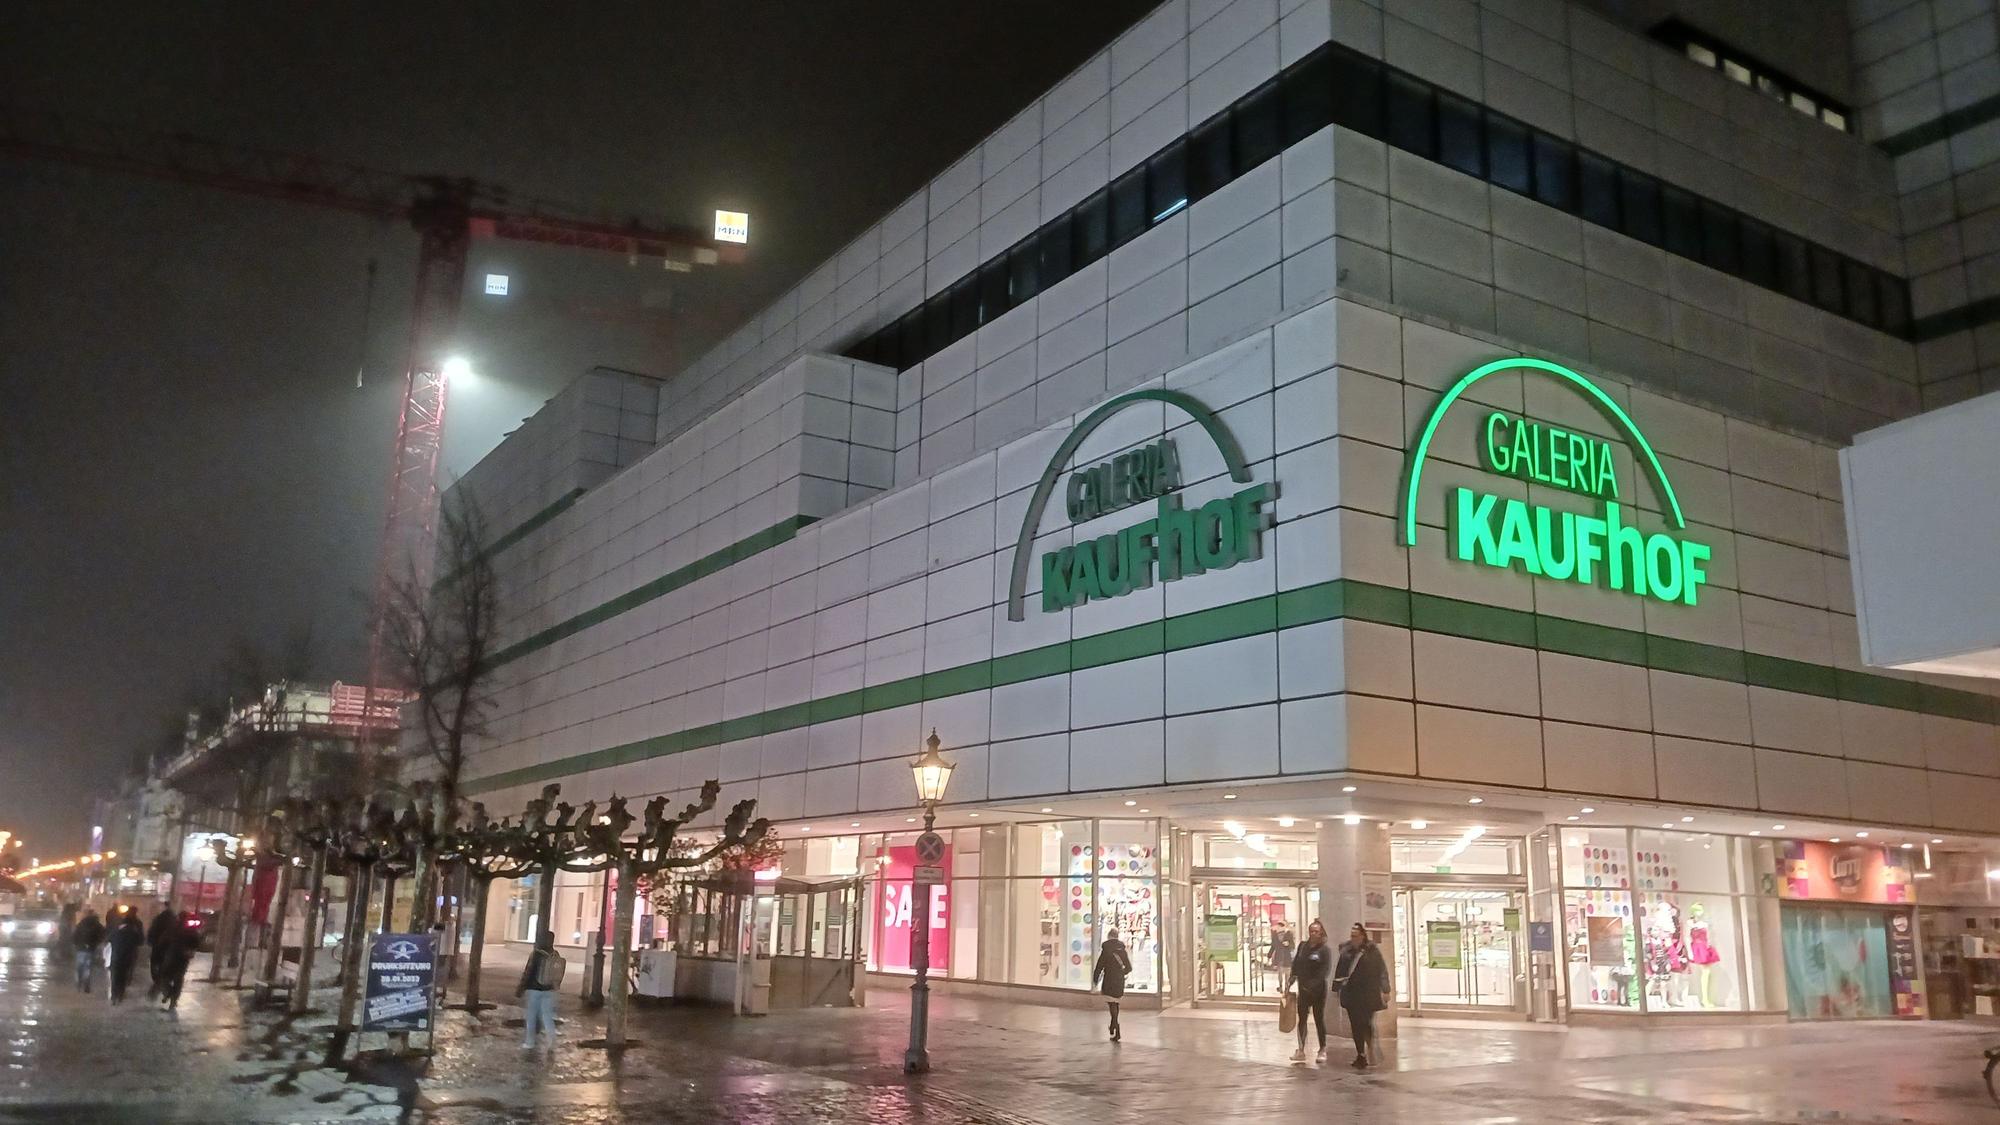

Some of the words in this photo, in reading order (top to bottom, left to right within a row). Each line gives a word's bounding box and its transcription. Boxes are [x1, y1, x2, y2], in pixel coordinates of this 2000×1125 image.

[1067, 438, 1183, 523] GALERIA
[1486, 412, 1619, 498] GALERIA
[884, 884, 948, 929] SAE
